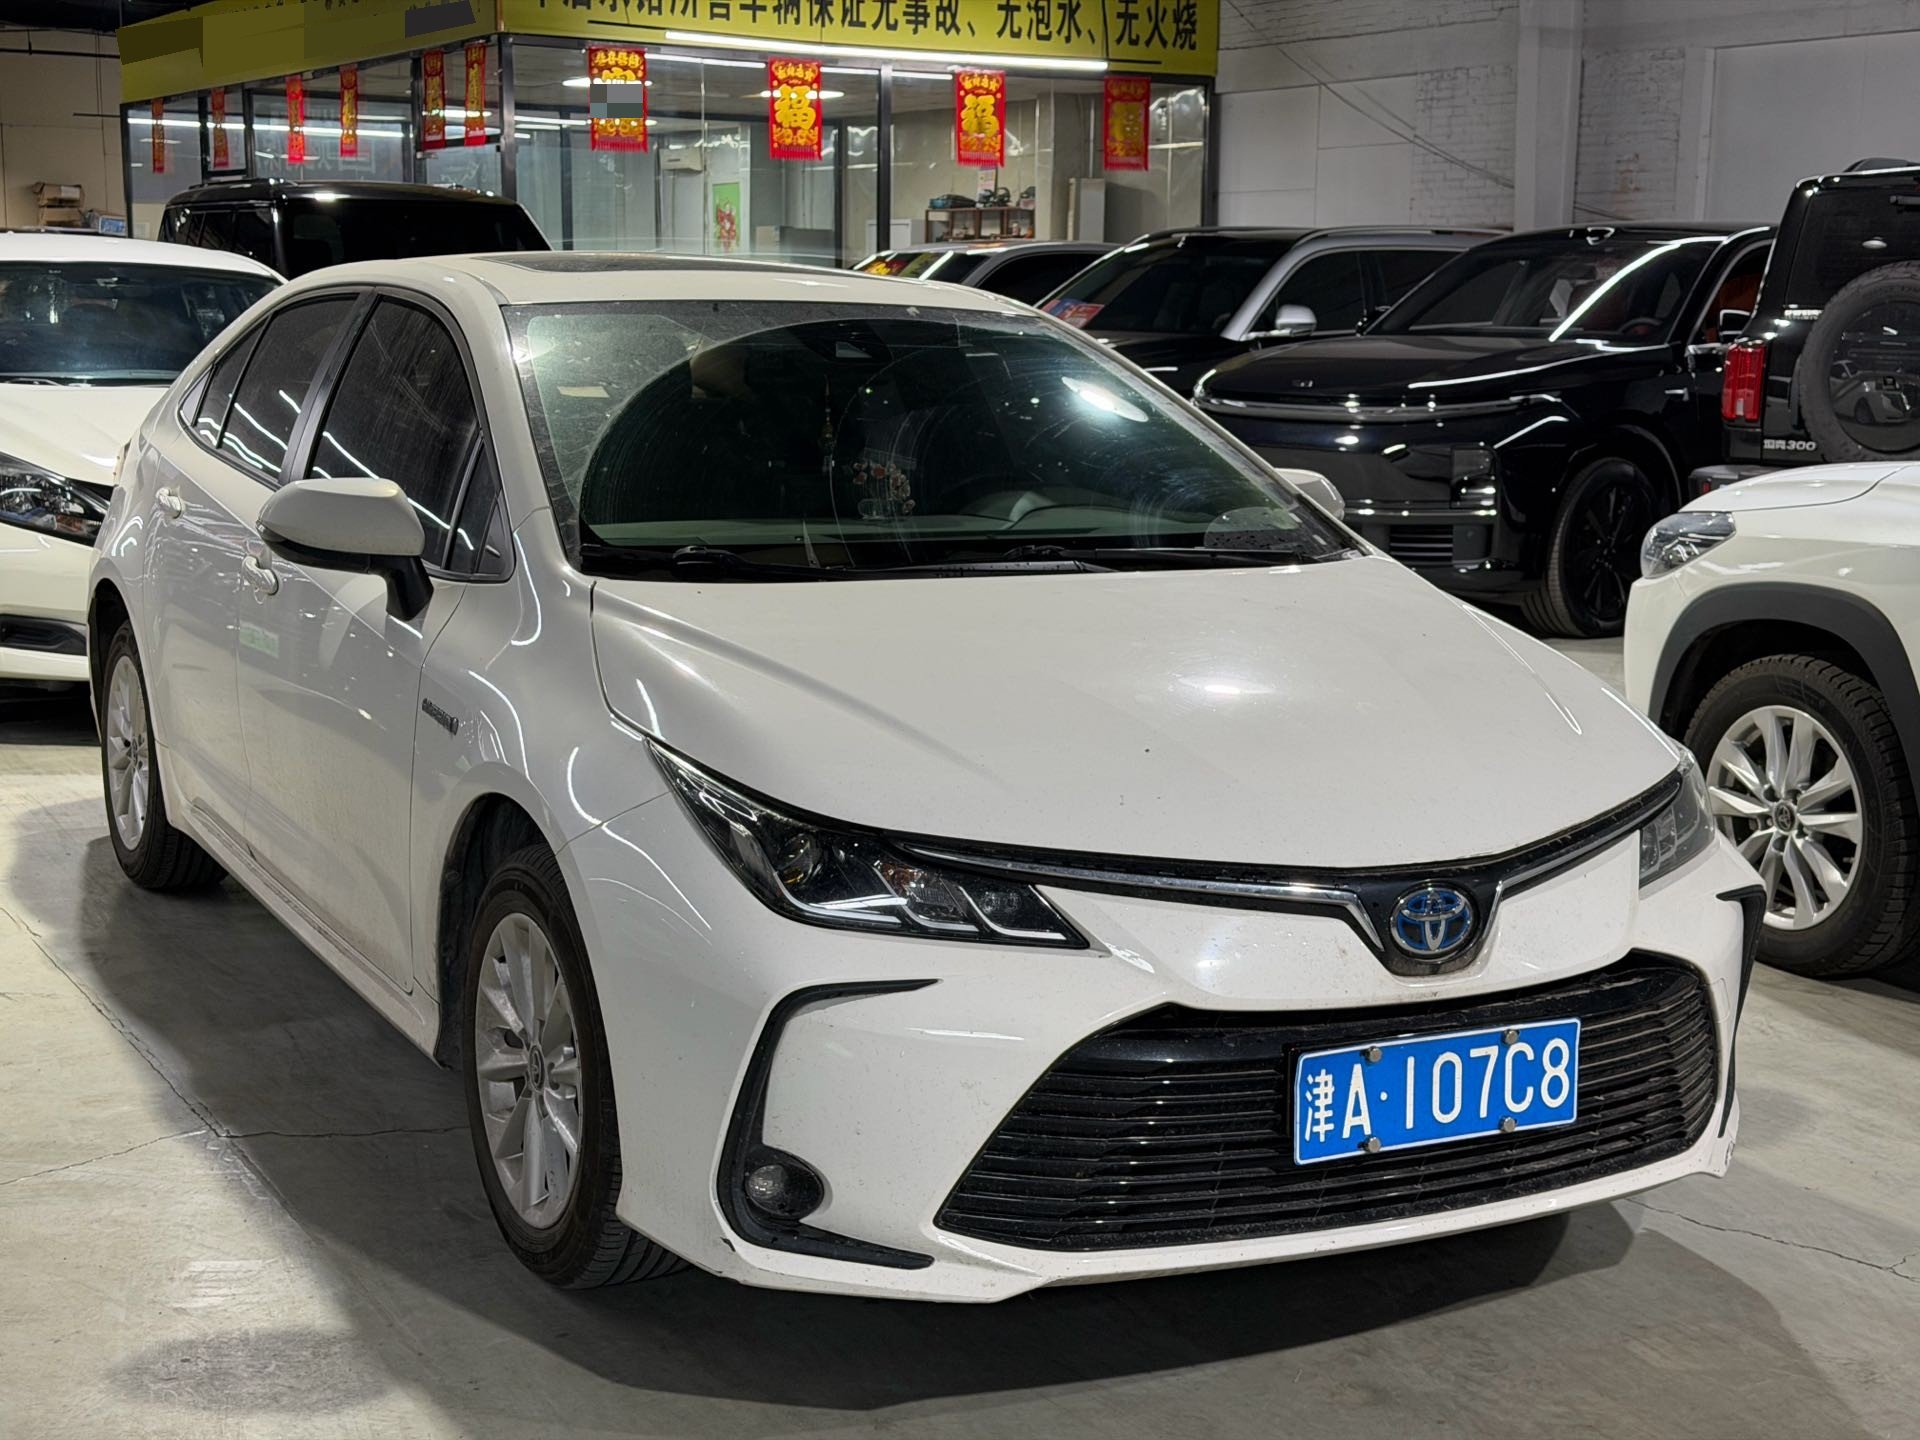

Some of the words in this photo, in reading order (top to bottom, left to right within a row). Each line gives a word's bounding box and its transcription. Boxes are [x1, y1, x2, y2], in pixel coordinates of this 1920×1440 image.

[540, 0, 1198, 50] 辆保证无事故、无泡水、无火烧
[774, 83, 816, 130] 福
[960, 94, 1000, 138] 福
[1304, 1037, 1570, 1143] 津A·107C8
